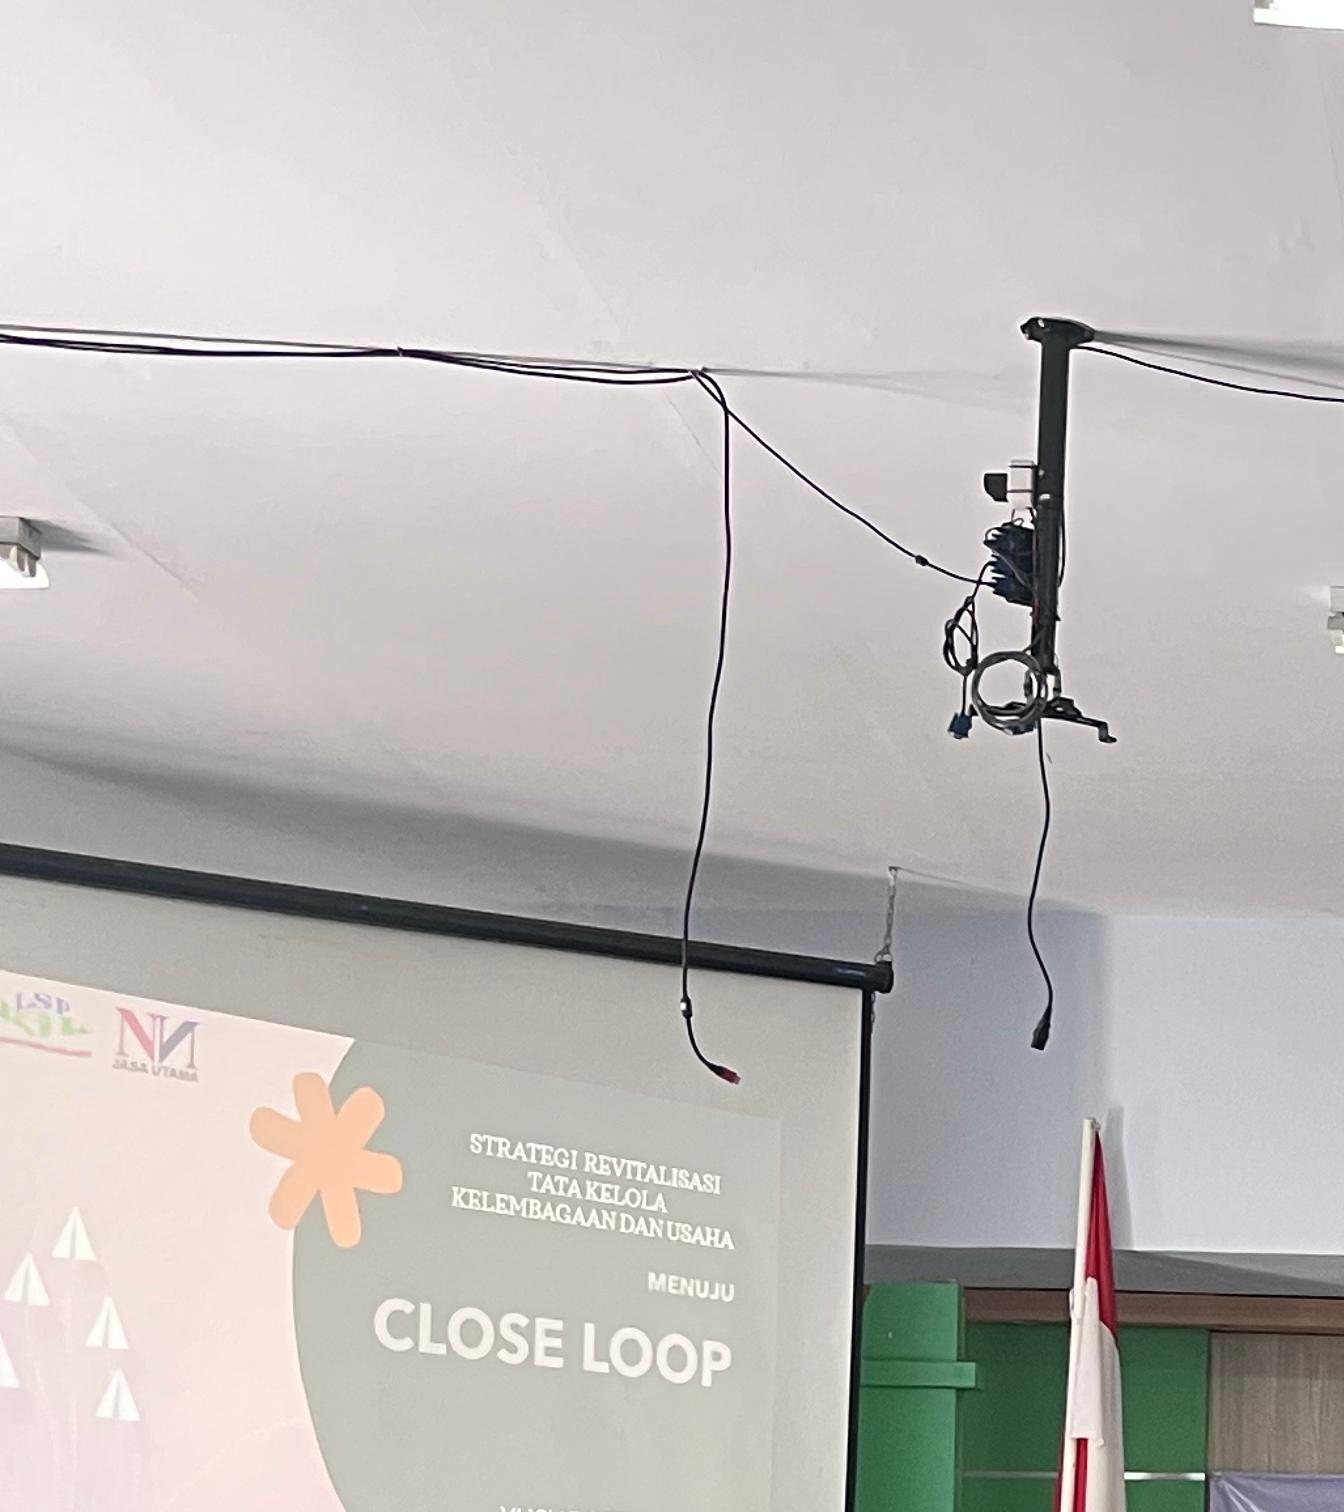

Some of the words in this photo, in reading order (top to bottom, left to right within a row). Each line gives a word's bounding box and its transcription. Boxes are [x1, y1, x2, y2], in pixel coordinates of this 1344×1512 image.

[112, 1059, 149, 1074] JASA
[152, 1064, 199, 1083] UTAMA
[469, 1133, 578, 1170] STRATEGI
[584, 1152, 722, 1195] REVITALISASI
[450, 1185, 616, 1231] KELEMBAGAAN
[619, 1212, 663, 1239] DAN
[666, 1221, 736, 1250] USAHA
[527, 1171, 582, 1199] TATA
[585, 1182, 668, 1214] KELOLA
[647, 1271, 736, 1302] MENUJU
[373, 1297, 565, 1369] CLOSE
[582, 1321, 732, 1388] LOOP
